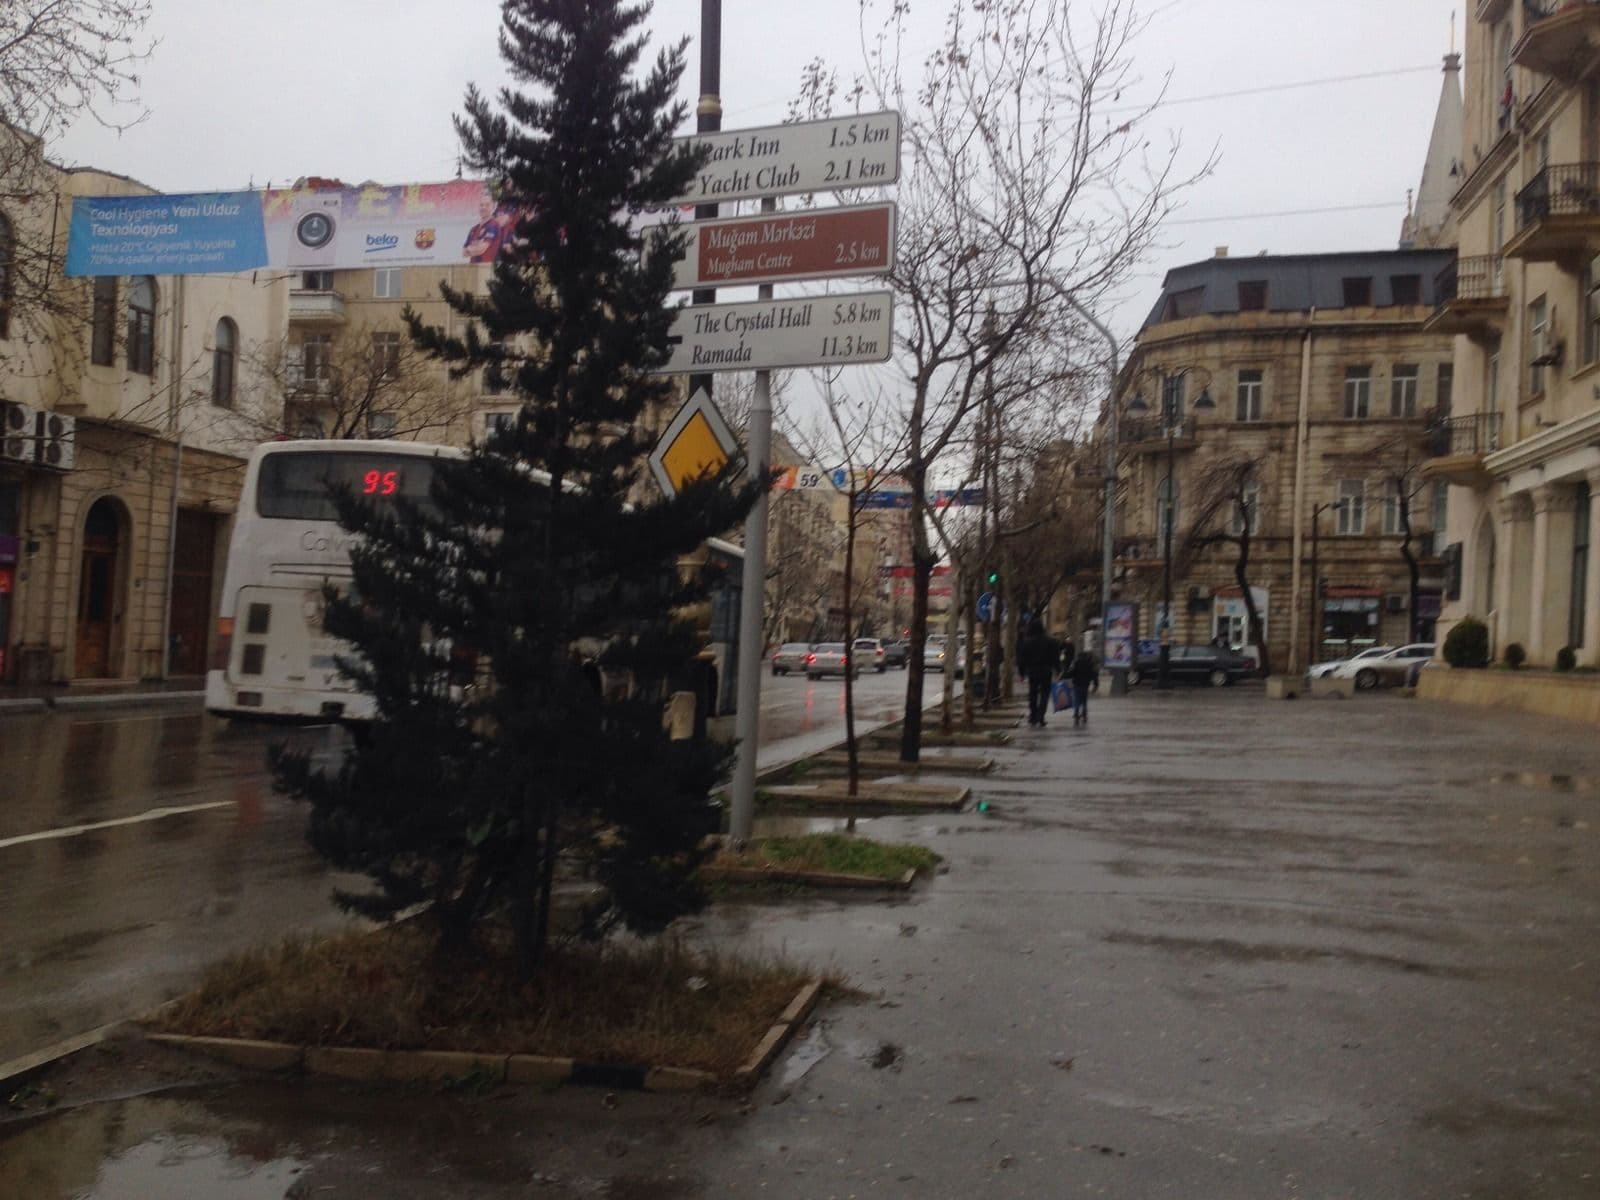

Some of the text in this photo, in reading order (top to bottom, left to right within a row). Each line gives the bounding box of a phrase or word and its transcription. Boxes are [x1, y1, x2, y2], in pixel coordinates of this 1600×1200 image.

[749, 136, 780, 157] Inn
[829, 125, 857, 148] 1.5
[863, 124, 890, 143] km
[700, 157, 886, 195] Yacht Club 2.1 km
[118, 207, 168, 222] Hygiene
[171, 204, 200, 218] Yeni
[203, 203, 240, 217] Ulduz
[366, 233, 398, 246] beko
[708, 218, 817, 254] Muğam Mərkəzi
[706, 243, 880, 279] Mugham Centre 2.5 km
[694, 302, 881, 338] The Crystal Hall 5.8 km
[691, 336, 878, 365] Ramada 11.3 km
[363, 469, 398, 495] 95
